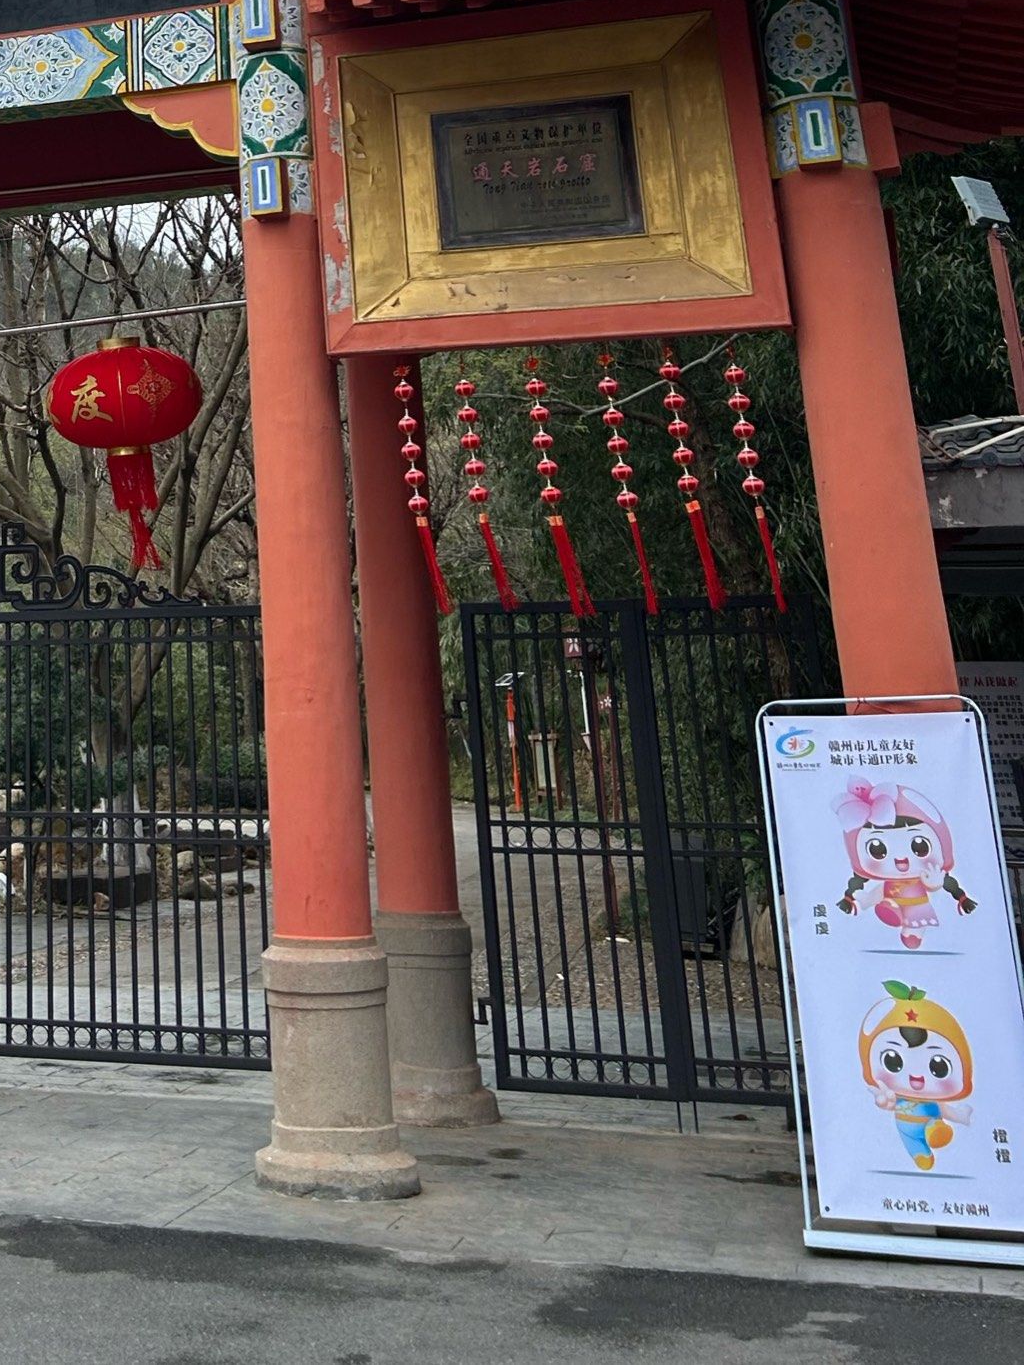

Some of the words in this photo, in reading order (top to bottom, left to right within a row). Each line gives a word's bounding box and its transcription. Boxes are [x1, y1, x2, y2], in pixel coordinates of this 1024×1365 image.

[472, 153, 596, 182] 通天岩石窟
[47, 375, 113, 424] 度
[828, 738, 915, 752] 赣州市儿童友好
[830, 752, 918, 766] 城市卡通IP形象
[992, 1128, 1012, 1163] 橙橙
